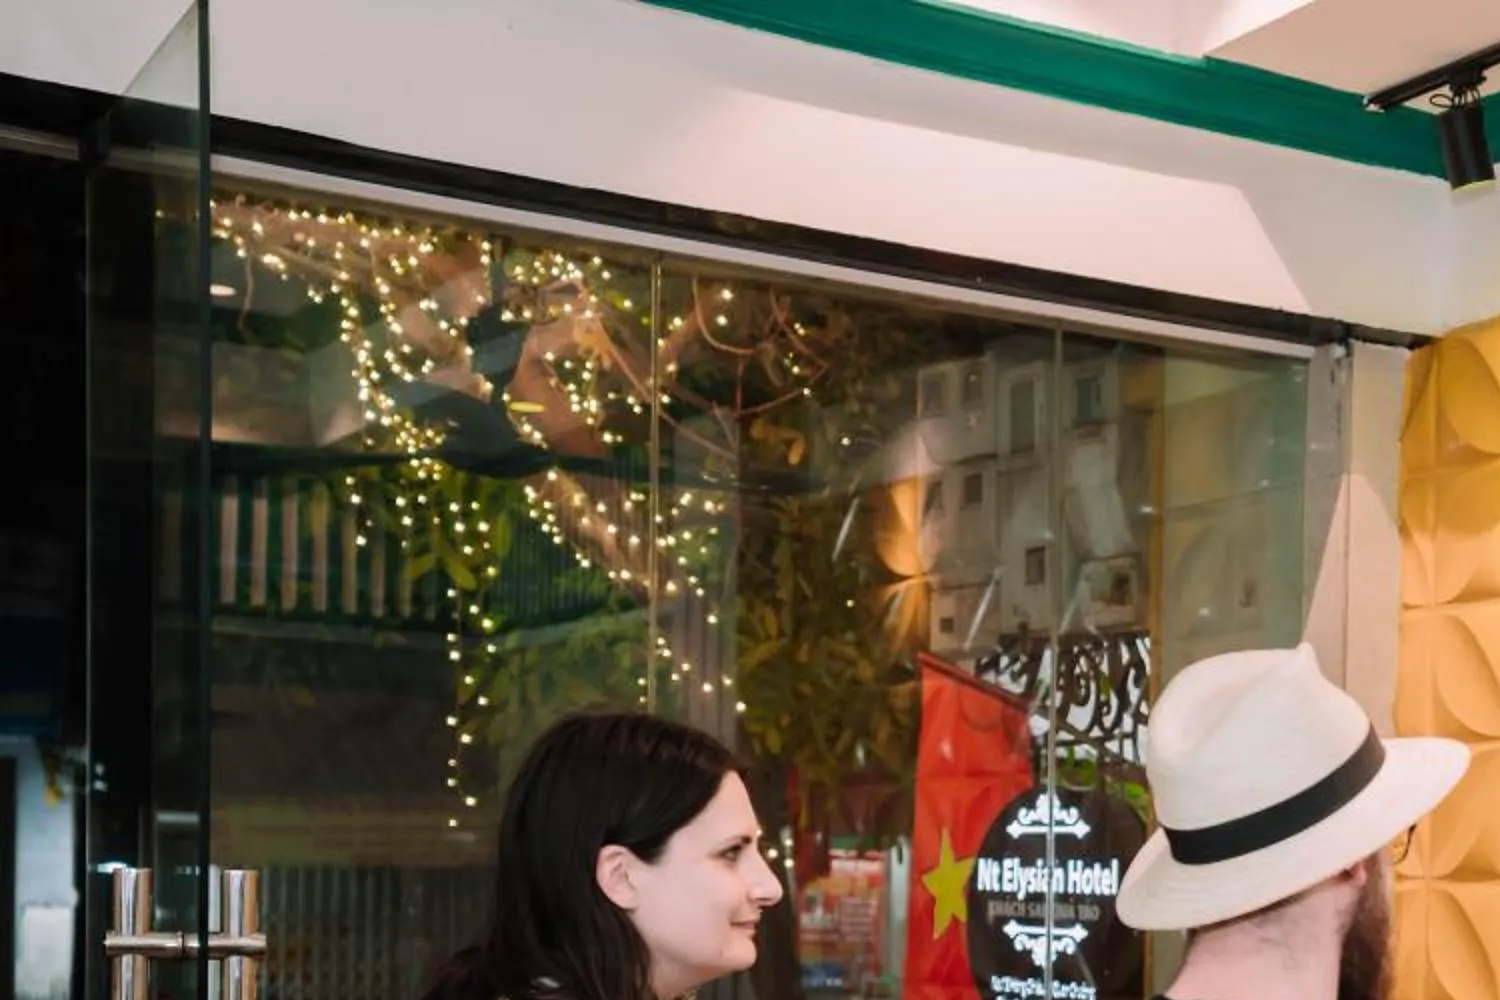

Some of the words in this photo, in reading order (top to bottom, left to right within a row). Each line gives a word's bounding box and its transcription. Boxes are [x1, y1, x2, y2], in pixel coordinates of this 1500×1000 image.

[977, 857, 1000, 892] Nt
[1002, 857, 1065, 901] Elysian
[1067, 858, 1120, 895] Hotel
